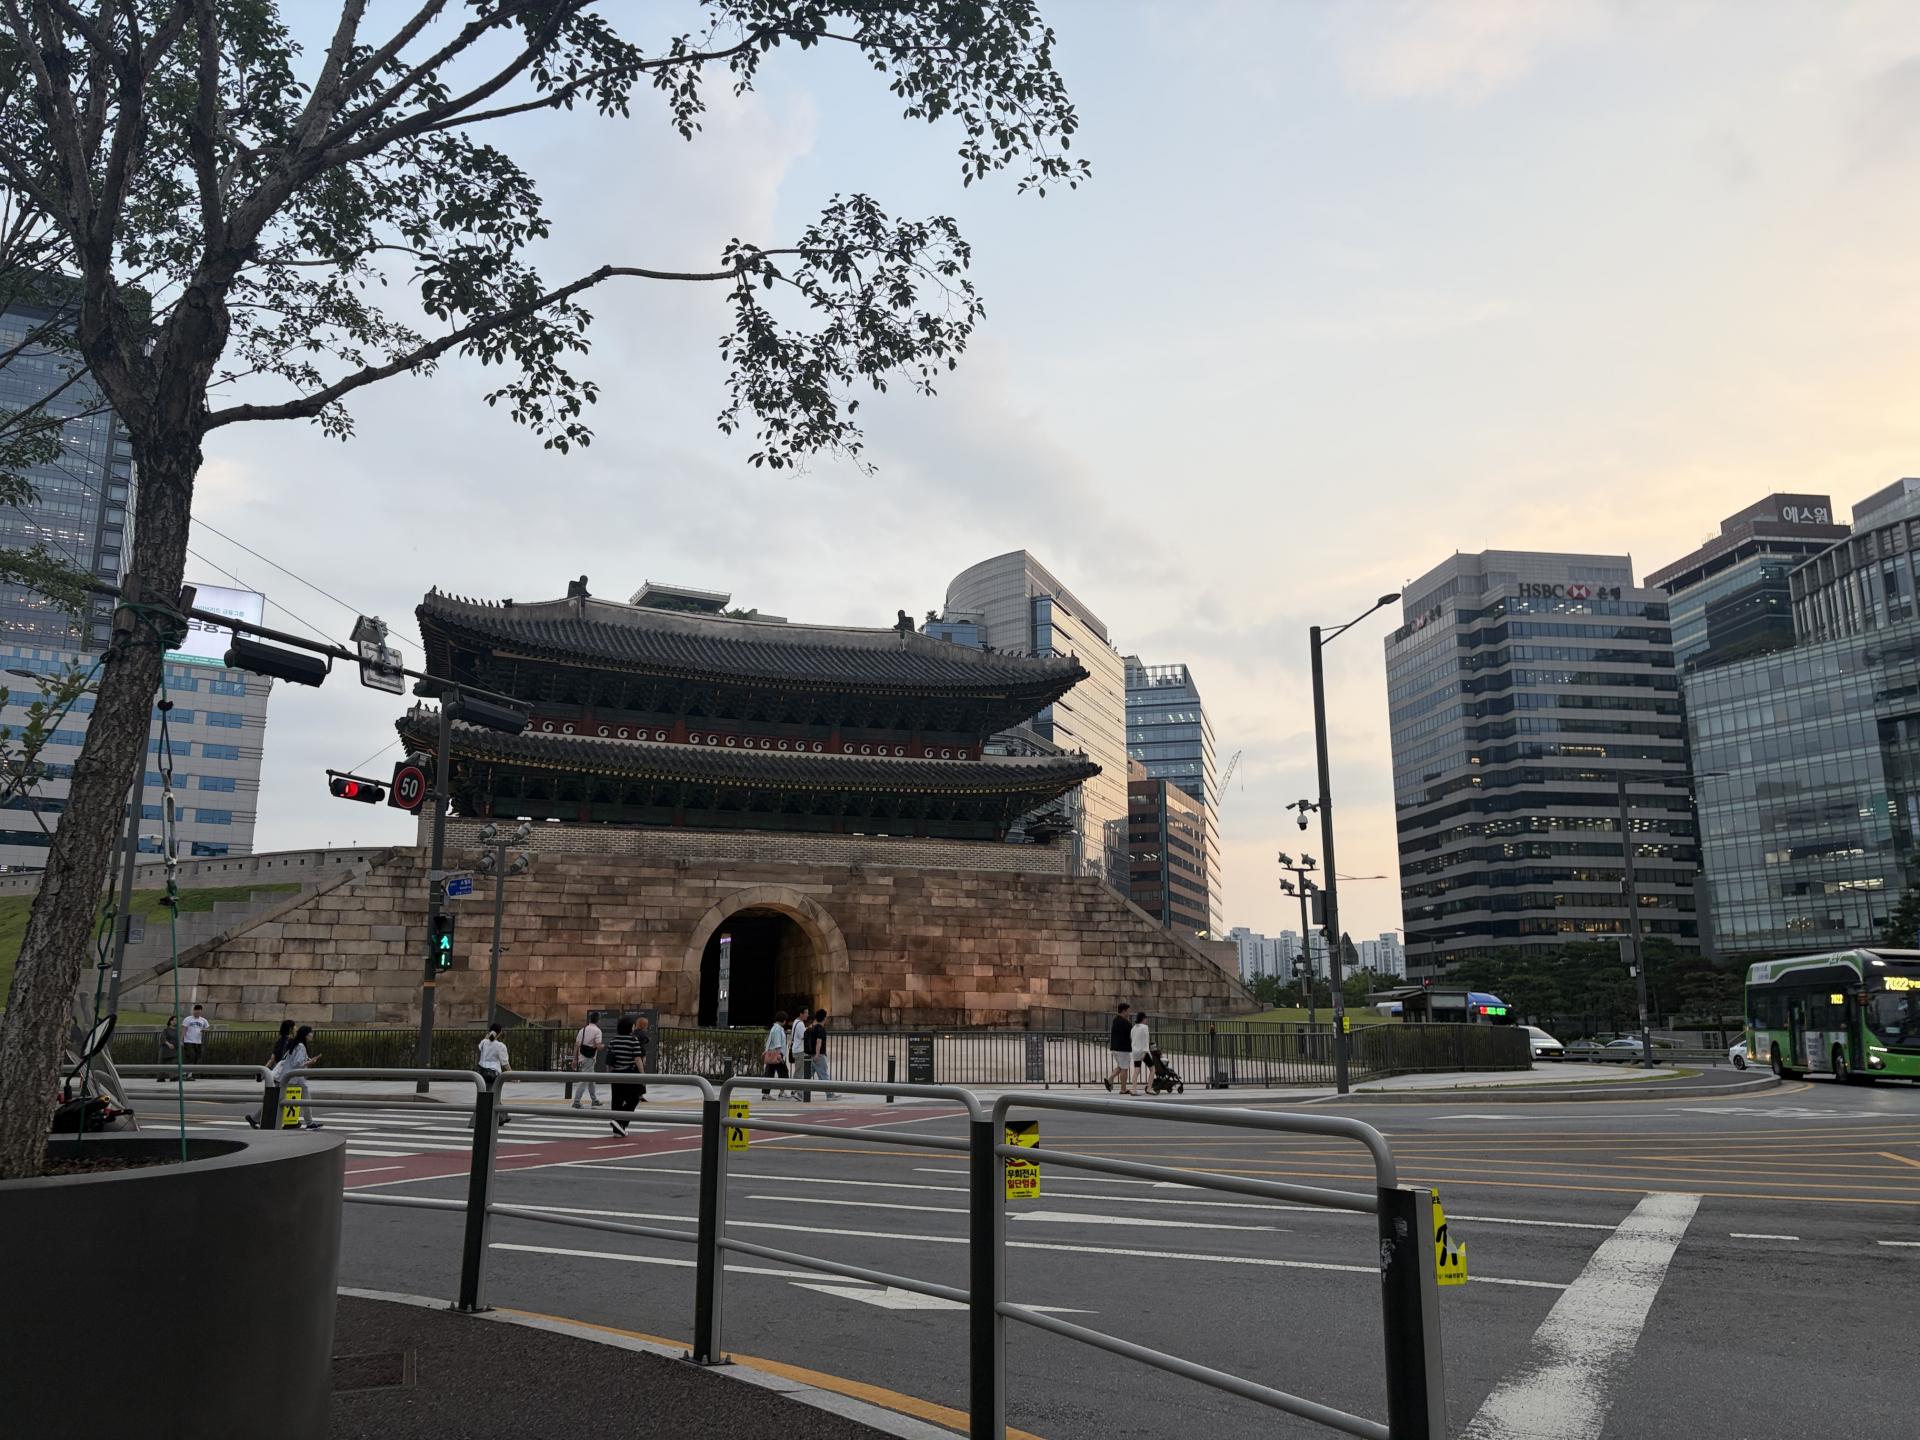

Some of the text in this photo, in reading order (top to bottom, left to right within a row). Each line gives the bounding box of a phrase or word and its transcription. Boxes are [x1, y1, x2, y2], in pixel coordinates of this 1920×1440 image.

[1783, 506, 1828, 524] 에스원
[1518, 582, 1564, 599] HSBC
[401, 777, 418, 798] 50
[1883, 976, 1909, 991] 7022
[1007, 1169, 1037, 1178] 우회전시
